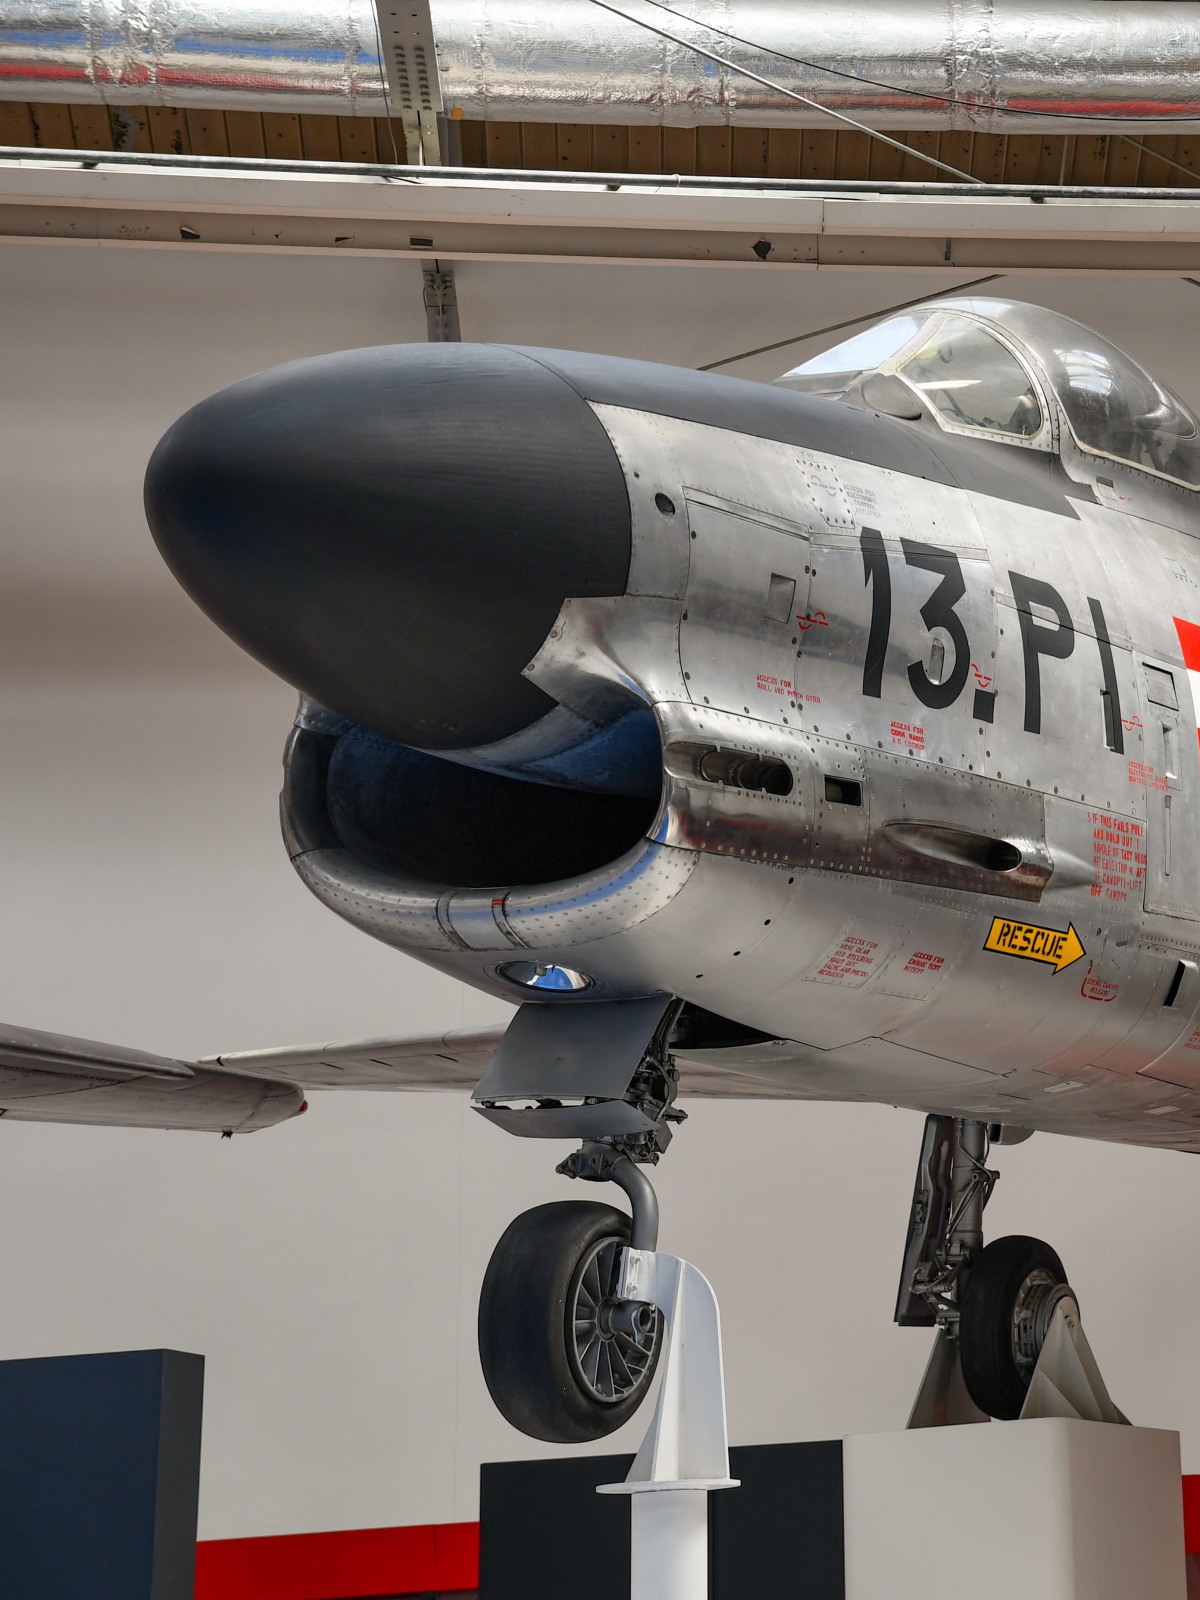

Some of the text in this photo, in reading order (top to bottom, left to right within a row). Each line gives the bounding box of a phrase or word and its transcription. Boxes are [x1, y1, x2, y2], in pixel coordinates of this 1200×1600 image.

[1092, 812, 1098, 824] IF
[1100, 814, 1112, 828] THIS
[1114, 818, 1128, 834] FAILS
[996, 922, 1068, 960] RESCUE
